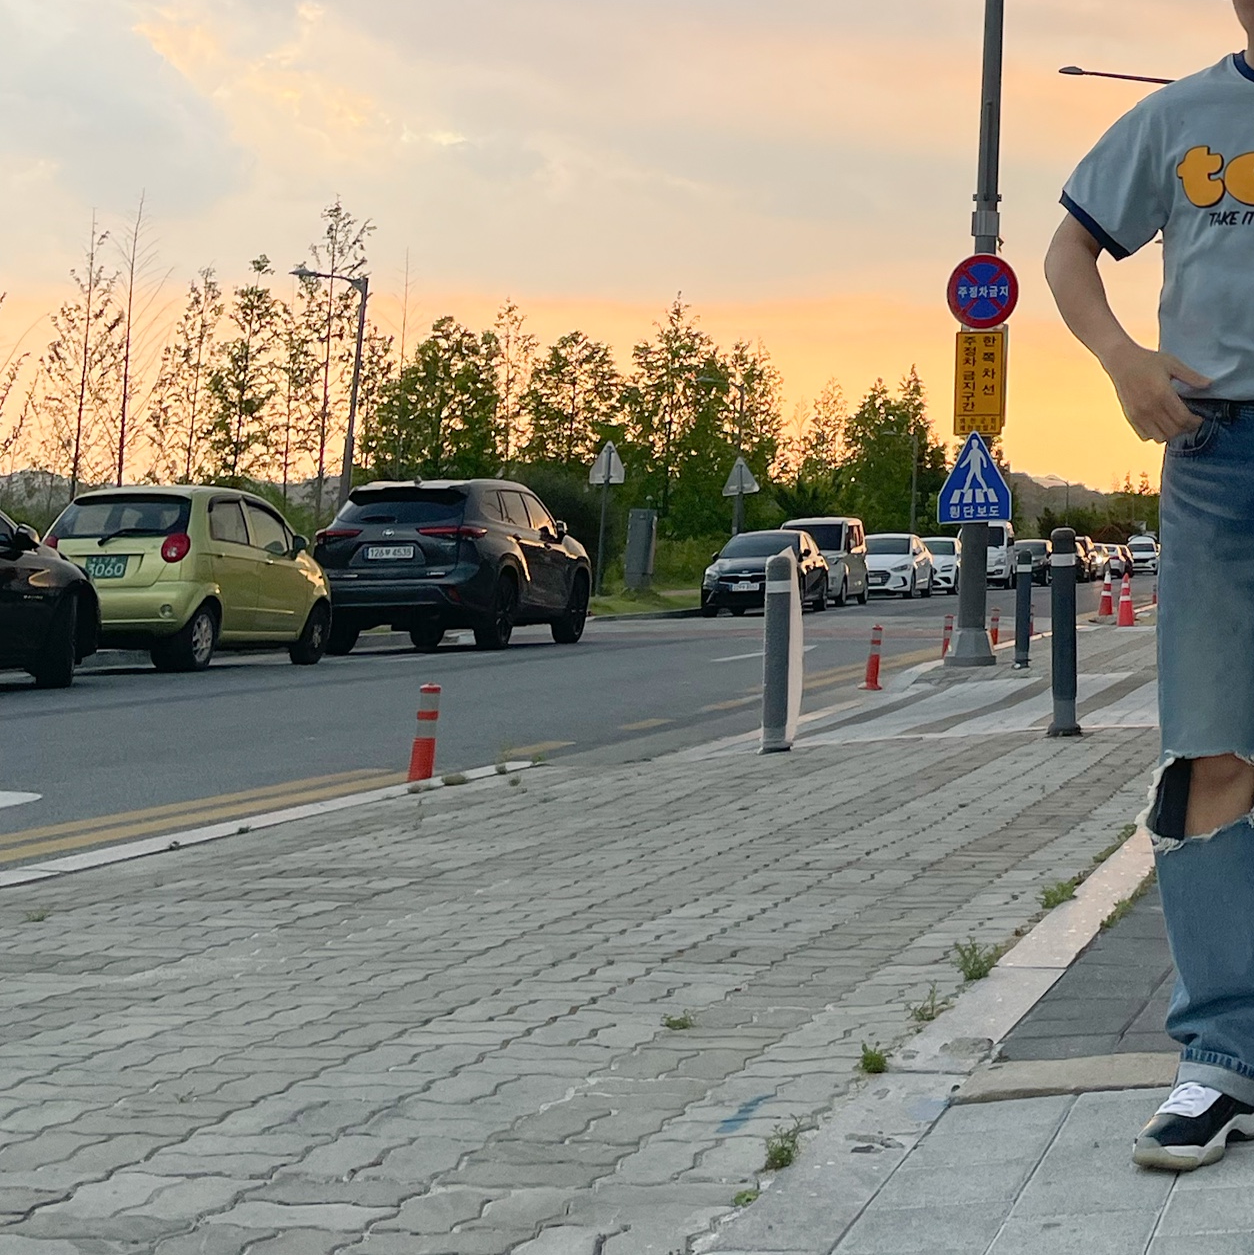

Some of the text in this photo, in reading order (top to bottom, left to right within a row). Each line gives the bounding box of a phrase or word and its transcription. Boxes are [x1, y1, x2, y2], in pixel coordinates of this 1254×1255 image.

[1209, 211, 1237, 227] TAKE
[957, 285, 1009, 298] 주정차금지
[949, 504, 1000, 518] 횡단보도
